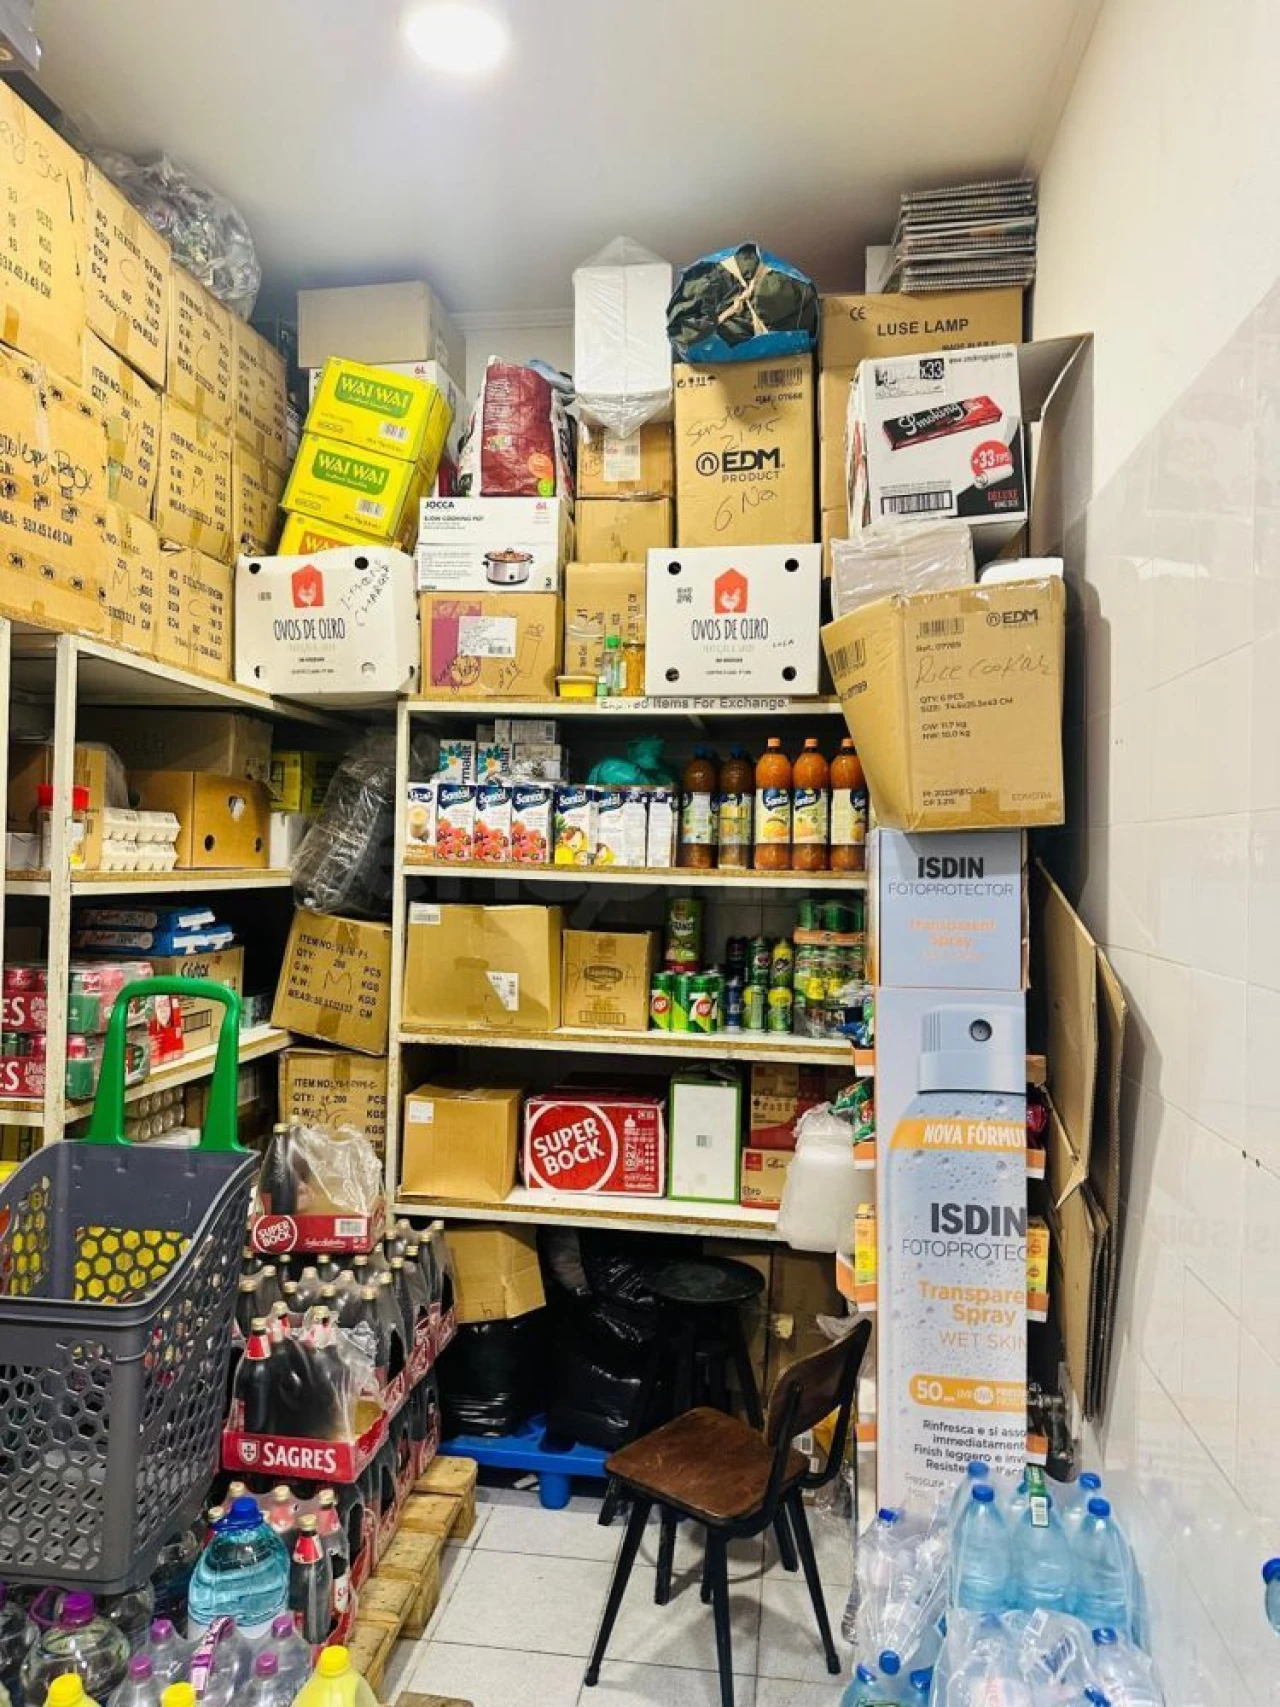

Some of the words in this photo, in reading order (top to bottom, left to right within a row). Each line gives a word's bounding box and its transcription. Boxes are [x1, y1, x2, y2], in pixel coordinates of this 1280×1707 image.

[877, 321, 919, 336] LUSE
[925, 319, 968, 334] LAMP
[341, 376, 375, 398] WAI
[377, 387, 409, 408] WAI
[899, 402, 964, 435] Smoking
[722, 447, 781, 471] EDM
[319, 454, 351, 475] WAI
[353, 464, 385, 485] WAI
[722, 472, 780, 483] PRODUCT
[425, 501, 454, 509] JOCCA
[306, 535, 333, 549] WA
[1003, 609, 1038, 624] EDM
[273, 618, 301, 641] OVOS
[304, 618, 316, 640] DE
[318, 616, 346, 640] OIRO
[691, 618, 721, 641] OVOS
[724, 618, 737, 641] DE
[741, 617, 769, 641] OIRO
[653, 697, 688, 708] Items
[695, 697, 714, 708] For
[720, 697, 787, 711] Exchange.
[917, 857, 984, 879] ISDIN
[888, 881, 1014, 897] FOTOPROTECTOR
[364, 966, 382, 978] PCS
[361, 980, 380, 993] KGS
[358, 993, 377, 1006] KGS
[359, 1008, 373, 1020] CM
[294, 1077, 315, 1088] ITEM
[293, 1093, 315, 1103] QTY:
[366, 1108, 386, 1120] KGS
[364, 1124, 385, 1135] KGS
[533, 1117, 601, 1158] SUPER
[923, 1124, 962, 1145] NOVA
[543, 1138, 605, 1176] BOCK
[931, 1202, 1026, 1237] ISDIN
[258, 1220, 290, 1239] SUPER
[262, 1231, 293, 1247] BOCK
[919, 1280, 1025, 1305] Transpare
[953, 1304, 1016, 1326] Spray
[939, 1331, 980, 1348] WET
[987, 1331, 1026, 1350] SKIN
[922, 1419, 974, 1435] Rinfresca
[977, 1427, 985, 1435] e
[263, 1441, 338, 1474] SAGRES
[914, 1443, 943, 1458] Finish
[945, 1447, 991, 1463] leggero
[994, 1455, 1002, 1463] e
[926, 1459, 968, 1474] Resiste
